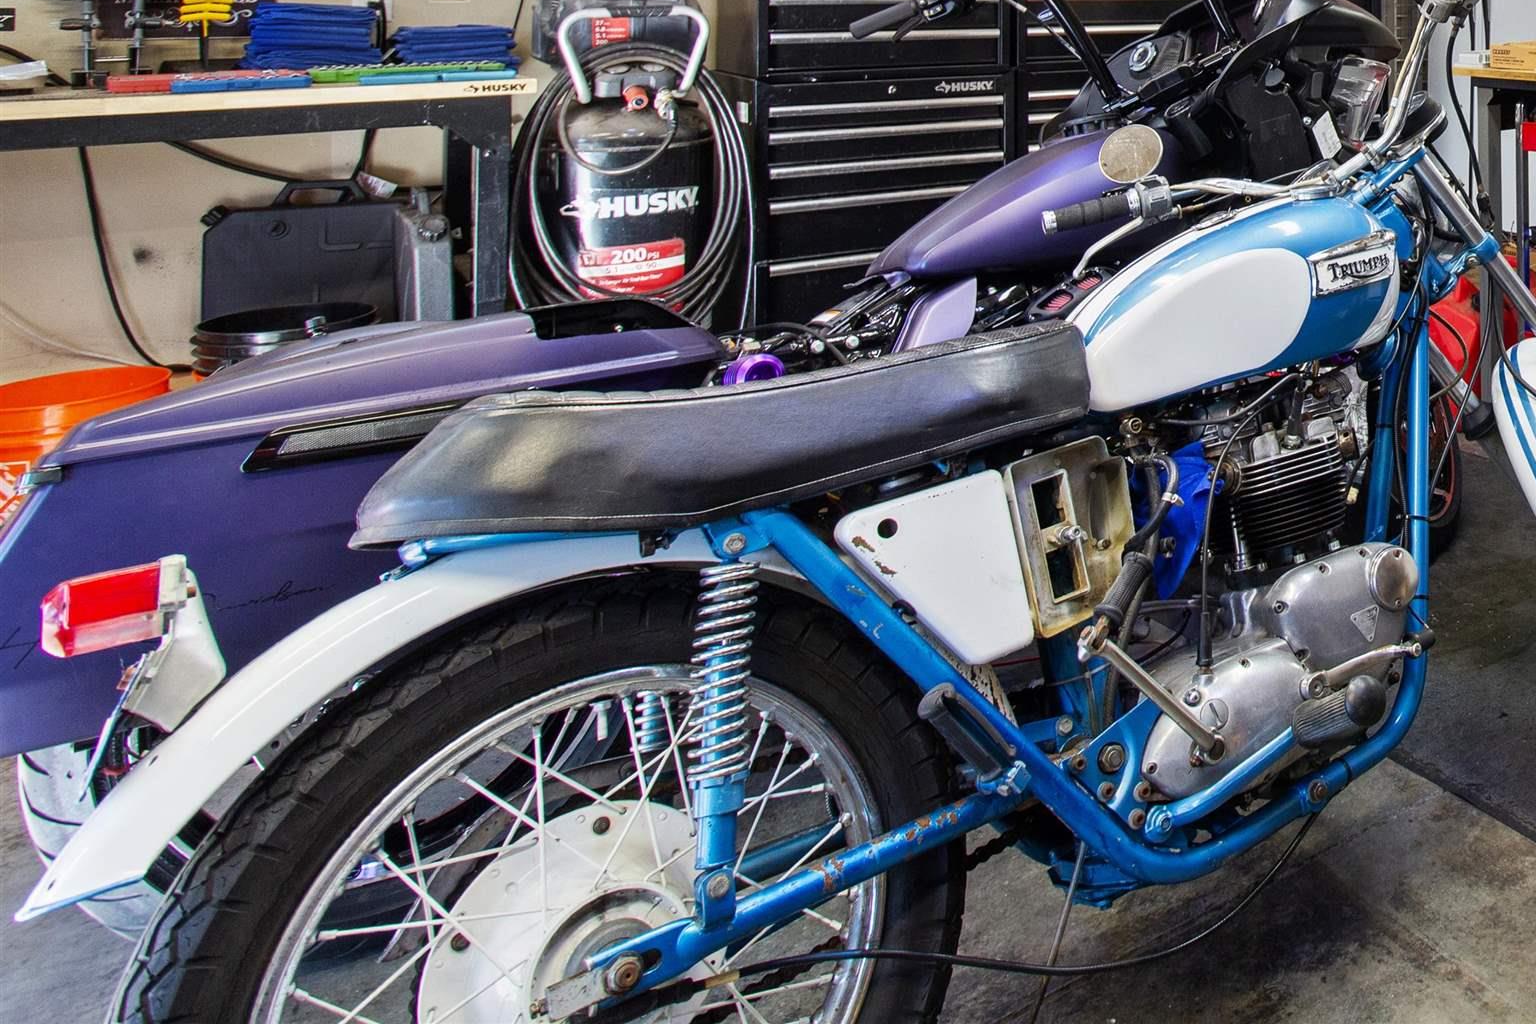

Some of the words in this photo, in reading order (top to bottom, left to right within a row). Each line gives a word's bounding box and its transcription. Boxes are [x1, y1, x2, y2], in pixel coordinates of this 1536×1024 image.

[482, 83, 528, 93] HUSKY
[951, 81, 994, 92] HUSKY
[597, 186, 699, 219] HUSKY
[611, 247, 648, 265] 200
